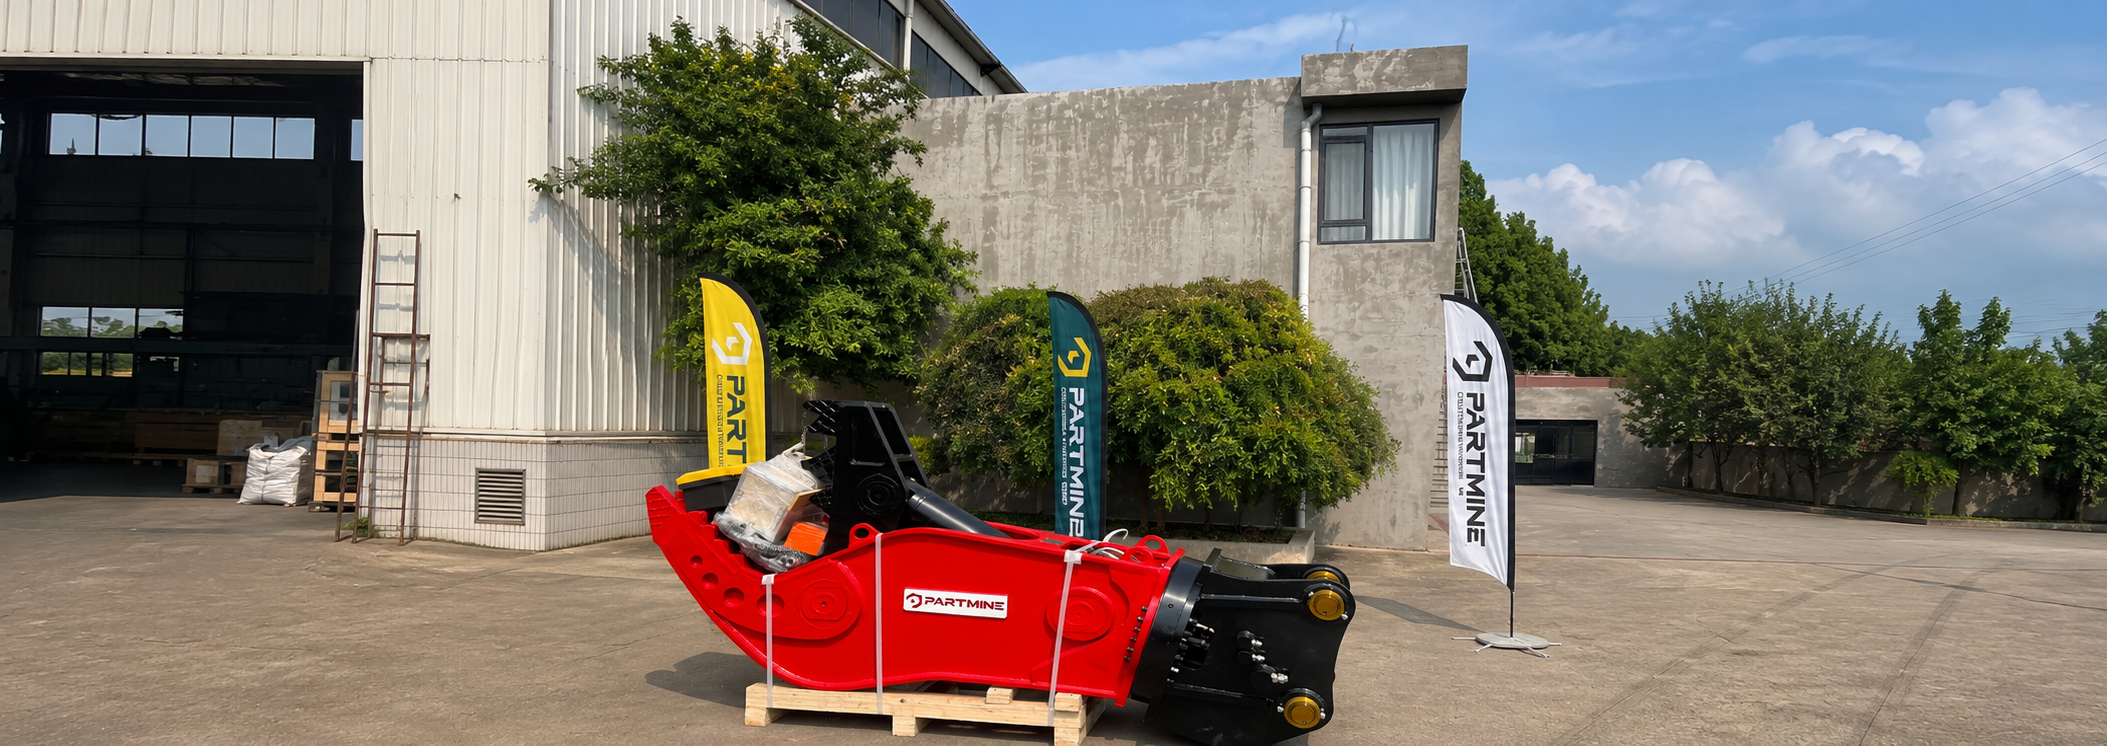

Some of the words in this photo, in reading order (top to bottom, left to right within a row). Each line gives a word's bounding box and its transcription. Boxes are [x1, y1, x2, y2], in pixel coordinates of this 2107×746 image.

[726, 375, 747, 466] PART
[1466, 392, 1486, 547] PARTMINE
[924, 596, 1005, 611] PARTMINE
